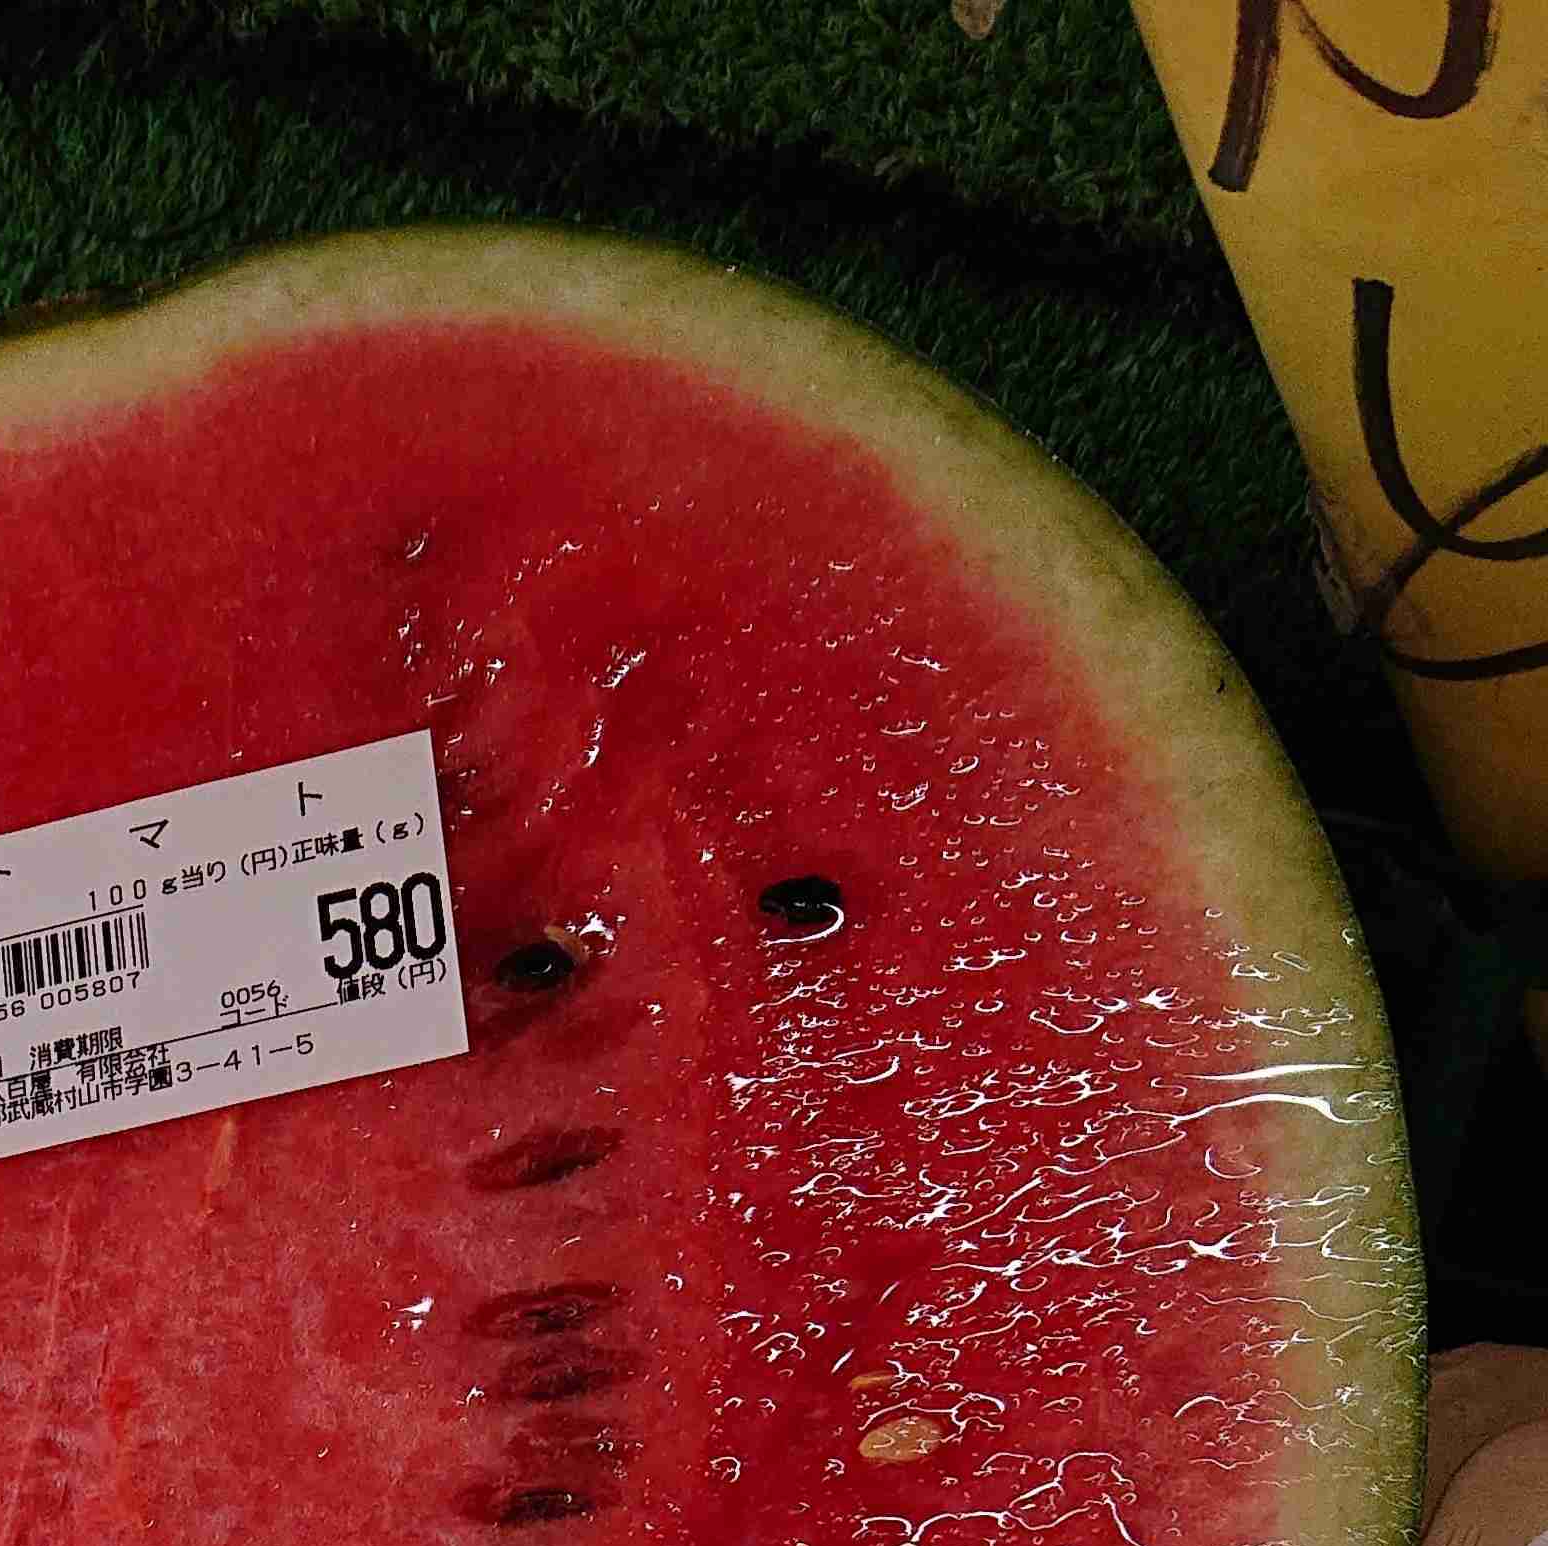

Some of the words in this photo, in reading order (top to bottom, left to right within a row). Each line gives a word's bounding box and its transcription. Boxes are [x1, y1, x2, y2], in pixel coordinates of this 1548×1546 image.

[316, 872, 447, 980] 580
[40, 971, 142, 1010] 005807
[220, 979, 282, 1009] 0056
[219, 994, 289, 1030] コード
[28, 1025, 124, 1072] 消費期限
[75, 1042, 171, 1085] 有限会社
